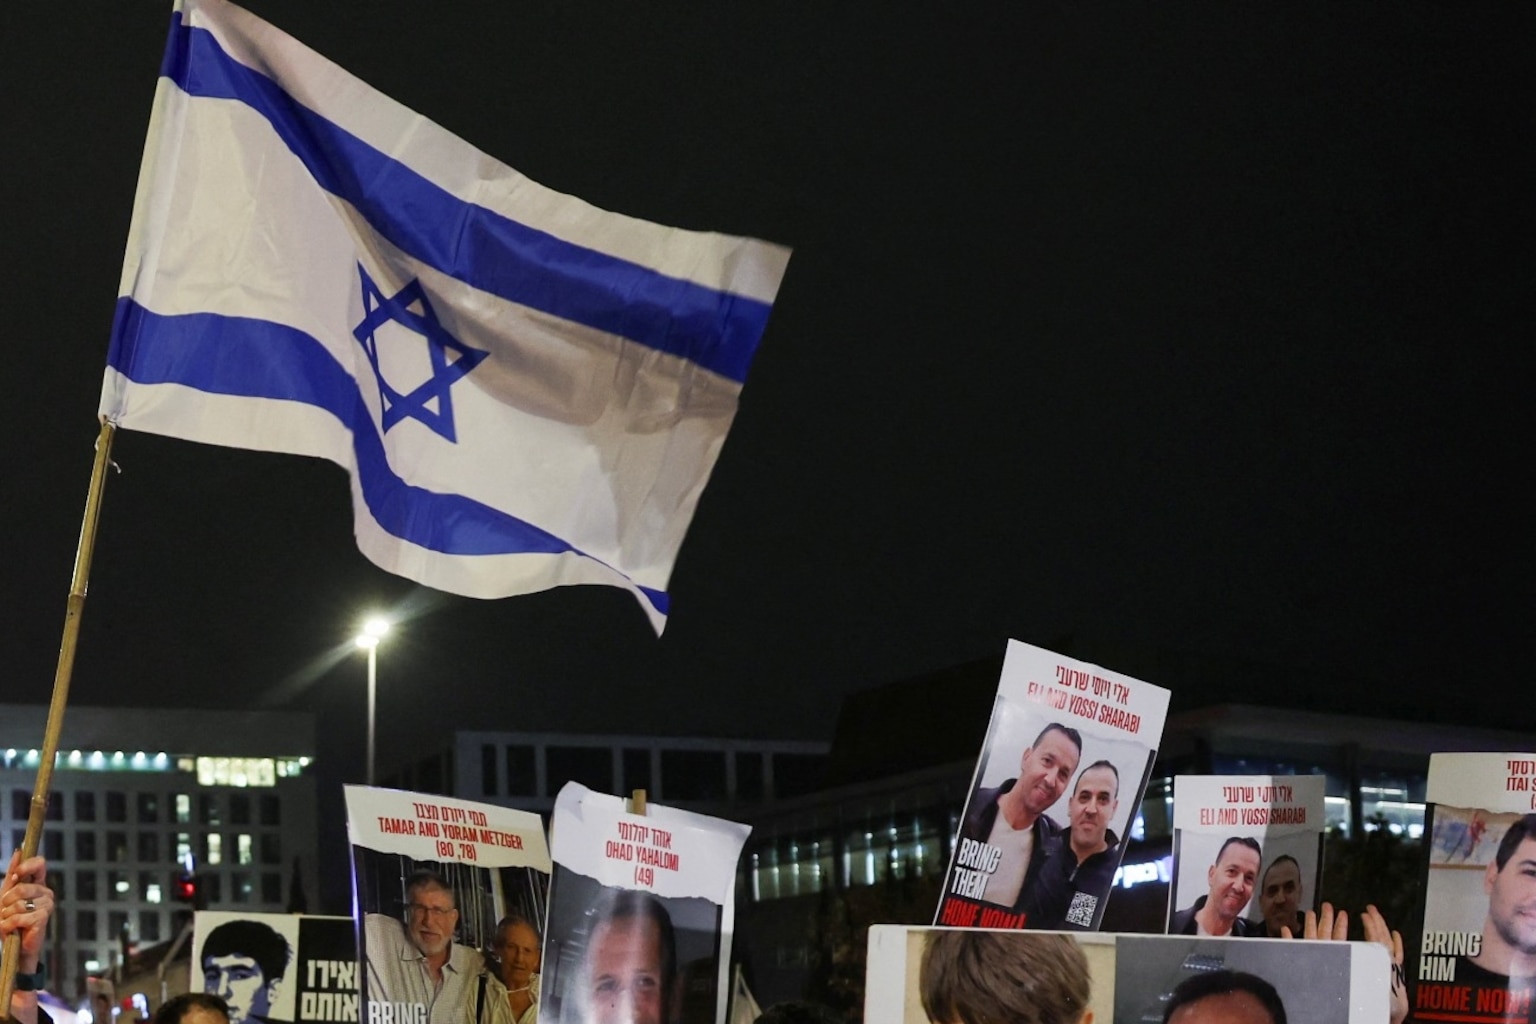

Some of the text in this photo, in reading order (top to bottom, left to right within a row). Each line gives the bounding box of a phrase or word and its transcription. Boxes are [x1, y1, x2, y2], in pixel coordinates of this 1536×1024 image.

[1056, 665, 1130, 705] אלי ויוסי שרעבי
[1047, 686, 1068, 709] AND
[1068, 694, 1099, 720] YOSSI
[1098, 704, 1141, 734] SHARABI
[1222, 786, 1254, 803] שרעבי
[1506, 777, 1529, 791] ITAI
[441, 806, 467, 824] ויורם
[467, 810, 488, 827] תמי
[1200, 808, 1307, 825] ELI AND YOSSI SHARABI
[378, 817, 524, 850] TAMAR AND YORAM METZGER
[618, 822, 672, 850] אוהד יהלומי
[606, 840, 680, 872] OHAD YAHALOMI
[957, 838, 1003, 874] BRING
[634, 865, 655, 888] (49)
[951, 867, 989, 900] THEM
[941, 898, 982, 928] HOME
[1421, 932, 1482, 957] BRING
[1419, 956, 1456, 982] HIM
[300, 992, 359, 1022] אותם
[1416, 984, 1530, 1015] HOME NOW!
